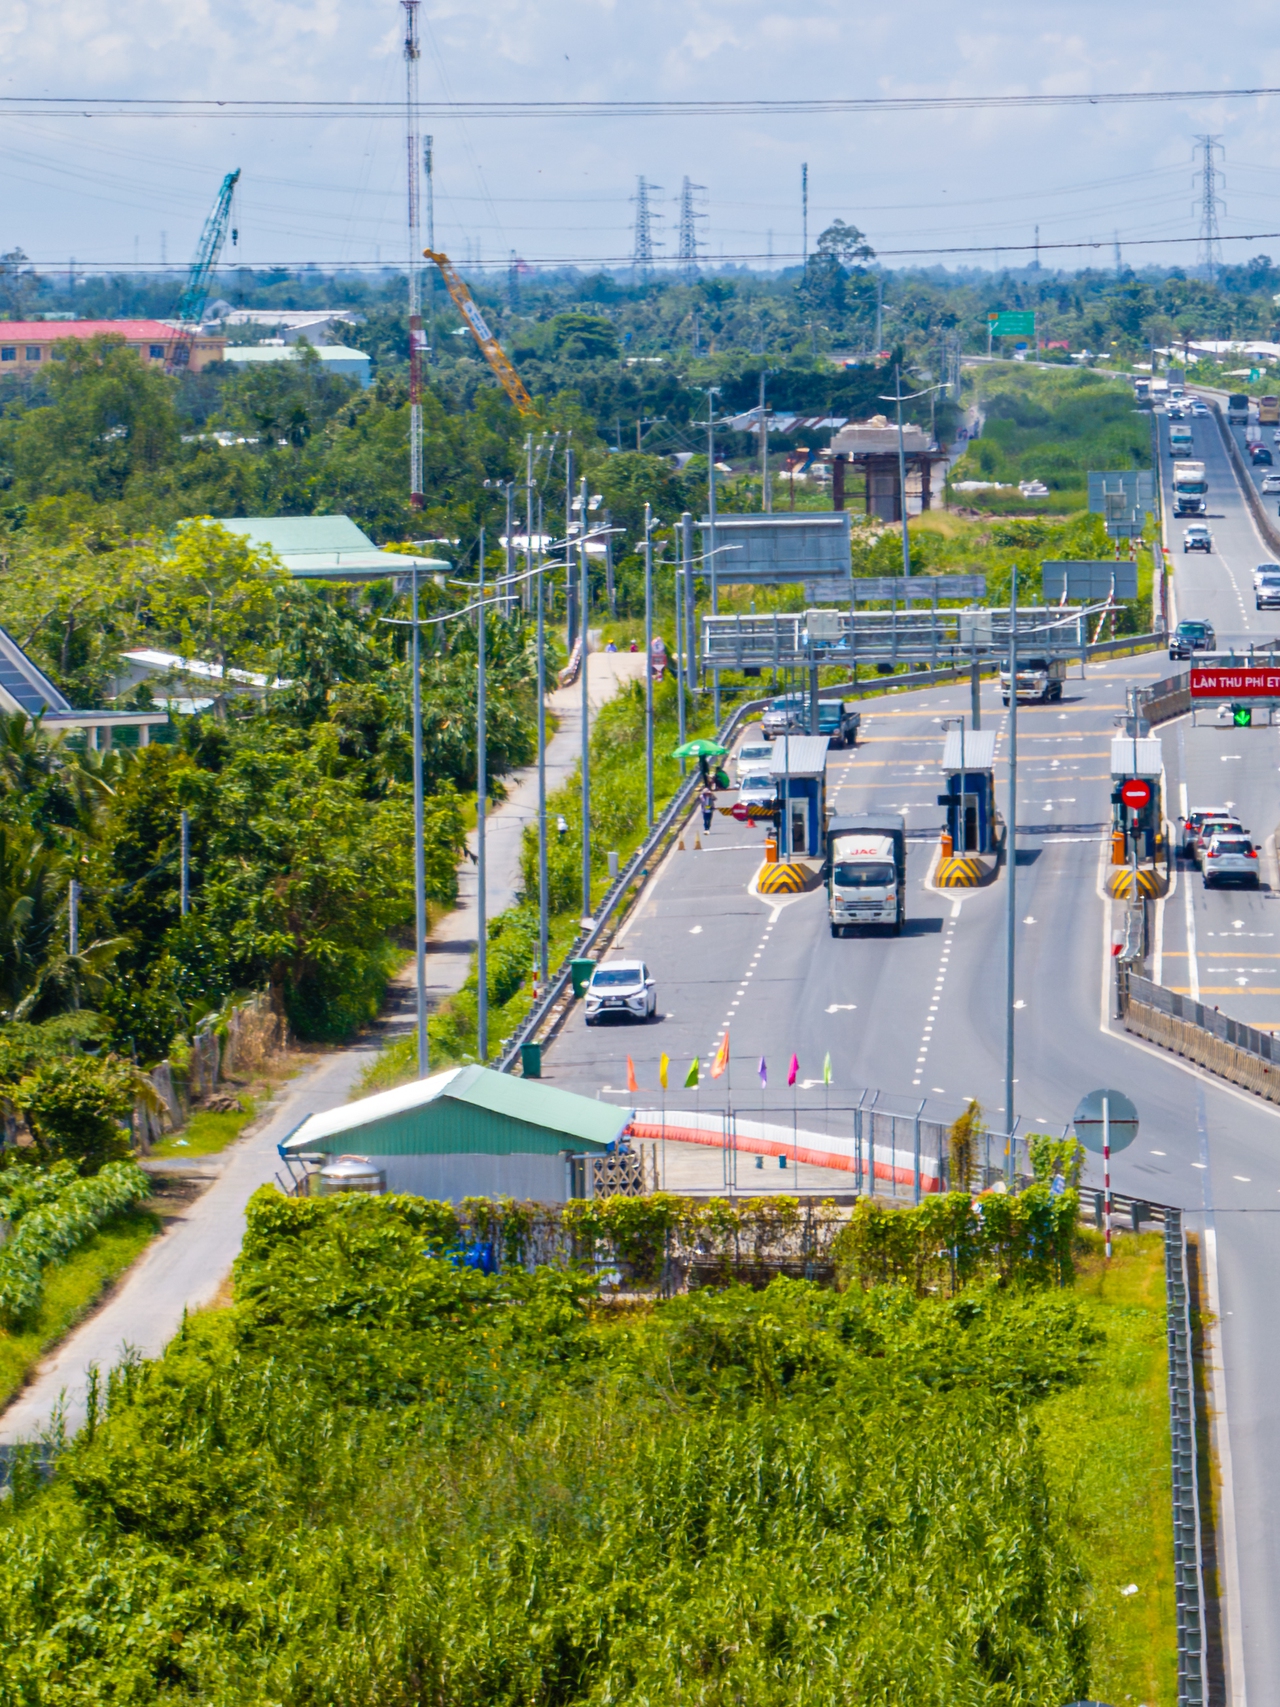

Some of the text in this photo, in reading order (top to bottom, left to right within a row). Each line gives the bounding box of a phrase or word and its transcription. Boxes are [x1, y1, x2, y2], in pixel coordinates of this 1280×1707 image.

[1193, 675, 1216, 688] LÀN
[1219, 677, 1242, 688] THU
[1245, 674, 1264, 688] PHÍ
[850, 848, 878, 856] JAC
